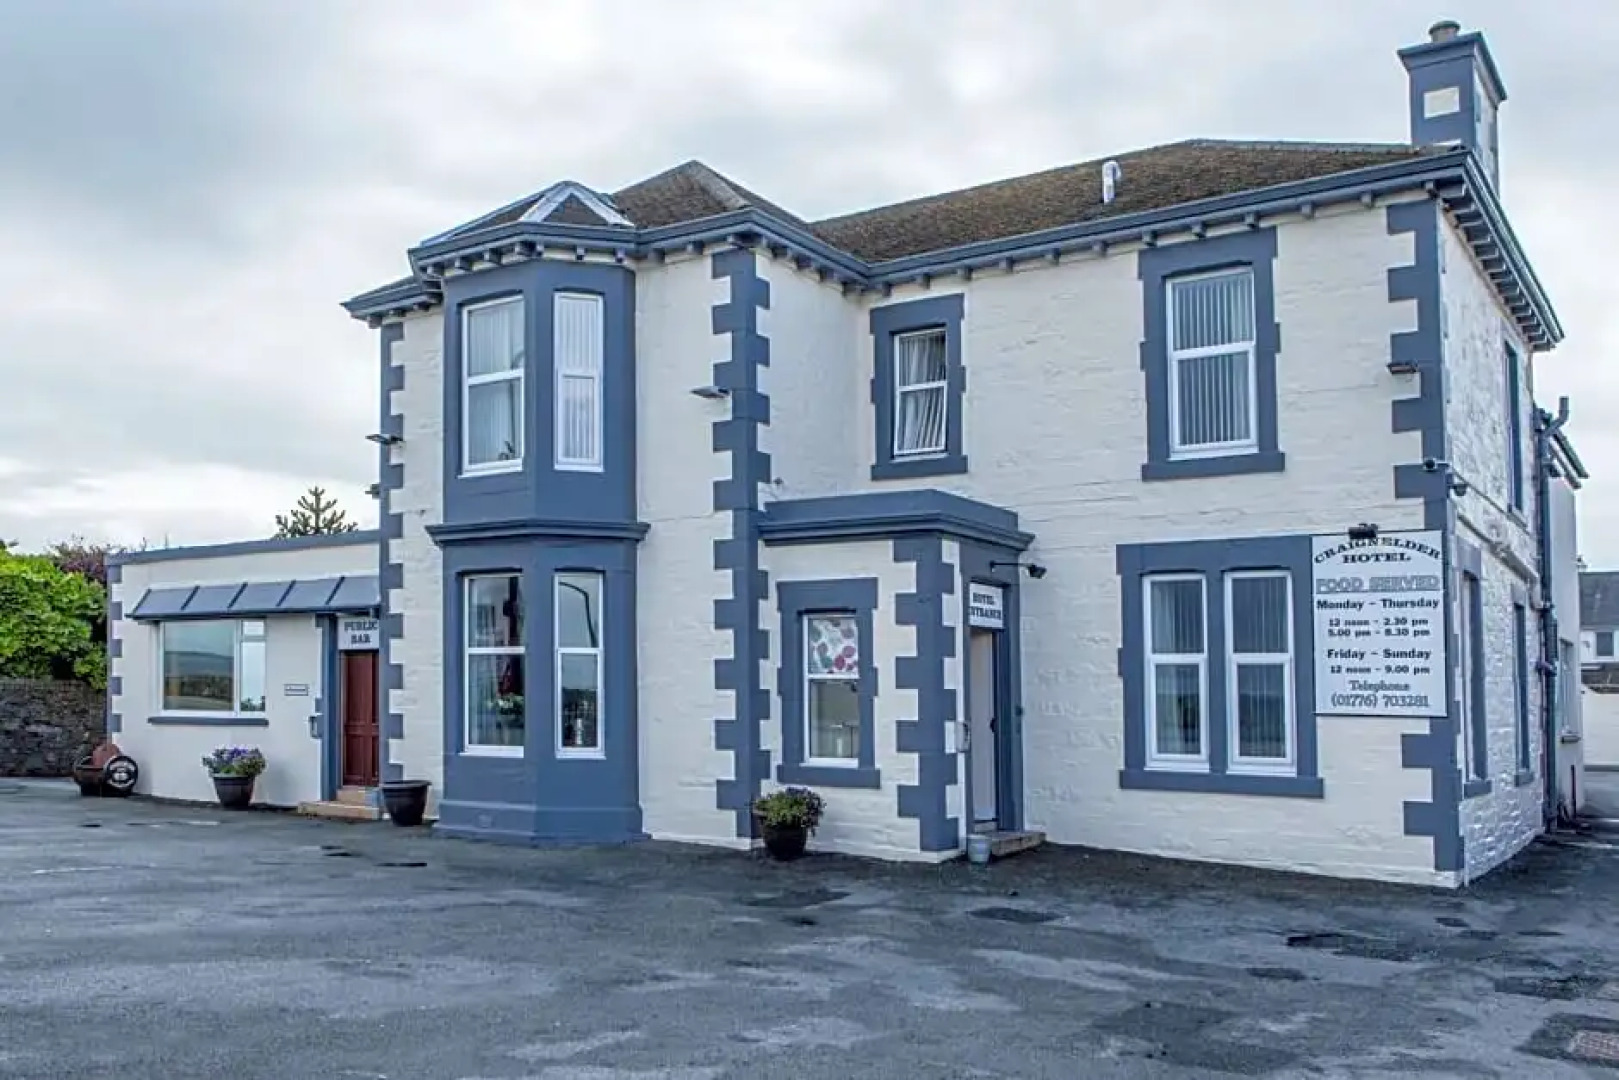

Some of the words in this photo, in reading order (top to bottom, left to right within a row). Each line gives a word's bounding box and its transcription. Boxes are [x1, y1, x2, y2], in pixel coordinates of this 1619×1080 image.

[1342, 552, 1411, 563] HOTEL
[1315, 577, 1364, 594] FOOD
[1368, 575, 1441, 592] SERVED
[972, 592, 995, 605] HOTEL
[1316, 600, 1364, 611] Monday
[1381, 598, 1440, 609] Thursday
[344, 621, 378, 631] PUBLIC
[1329, 618, 1340, 627] 12
[1412, 619, 1429, 627] pm
[351, 634, 370, 644] BAR
[1354, 630, 1371, 638] pm
[1413, 629, 1430, 638] pm
[1327, 648, 1366, 660] Friday
[1382, 647, 1432, 659] Sunday
[1330, 665, 1342, 674] 12
[1413, 667, 1430, 675] pm
[1348, 680, 1411, 692] Telephone
[1331, 693, 1378, 707] (01776)
